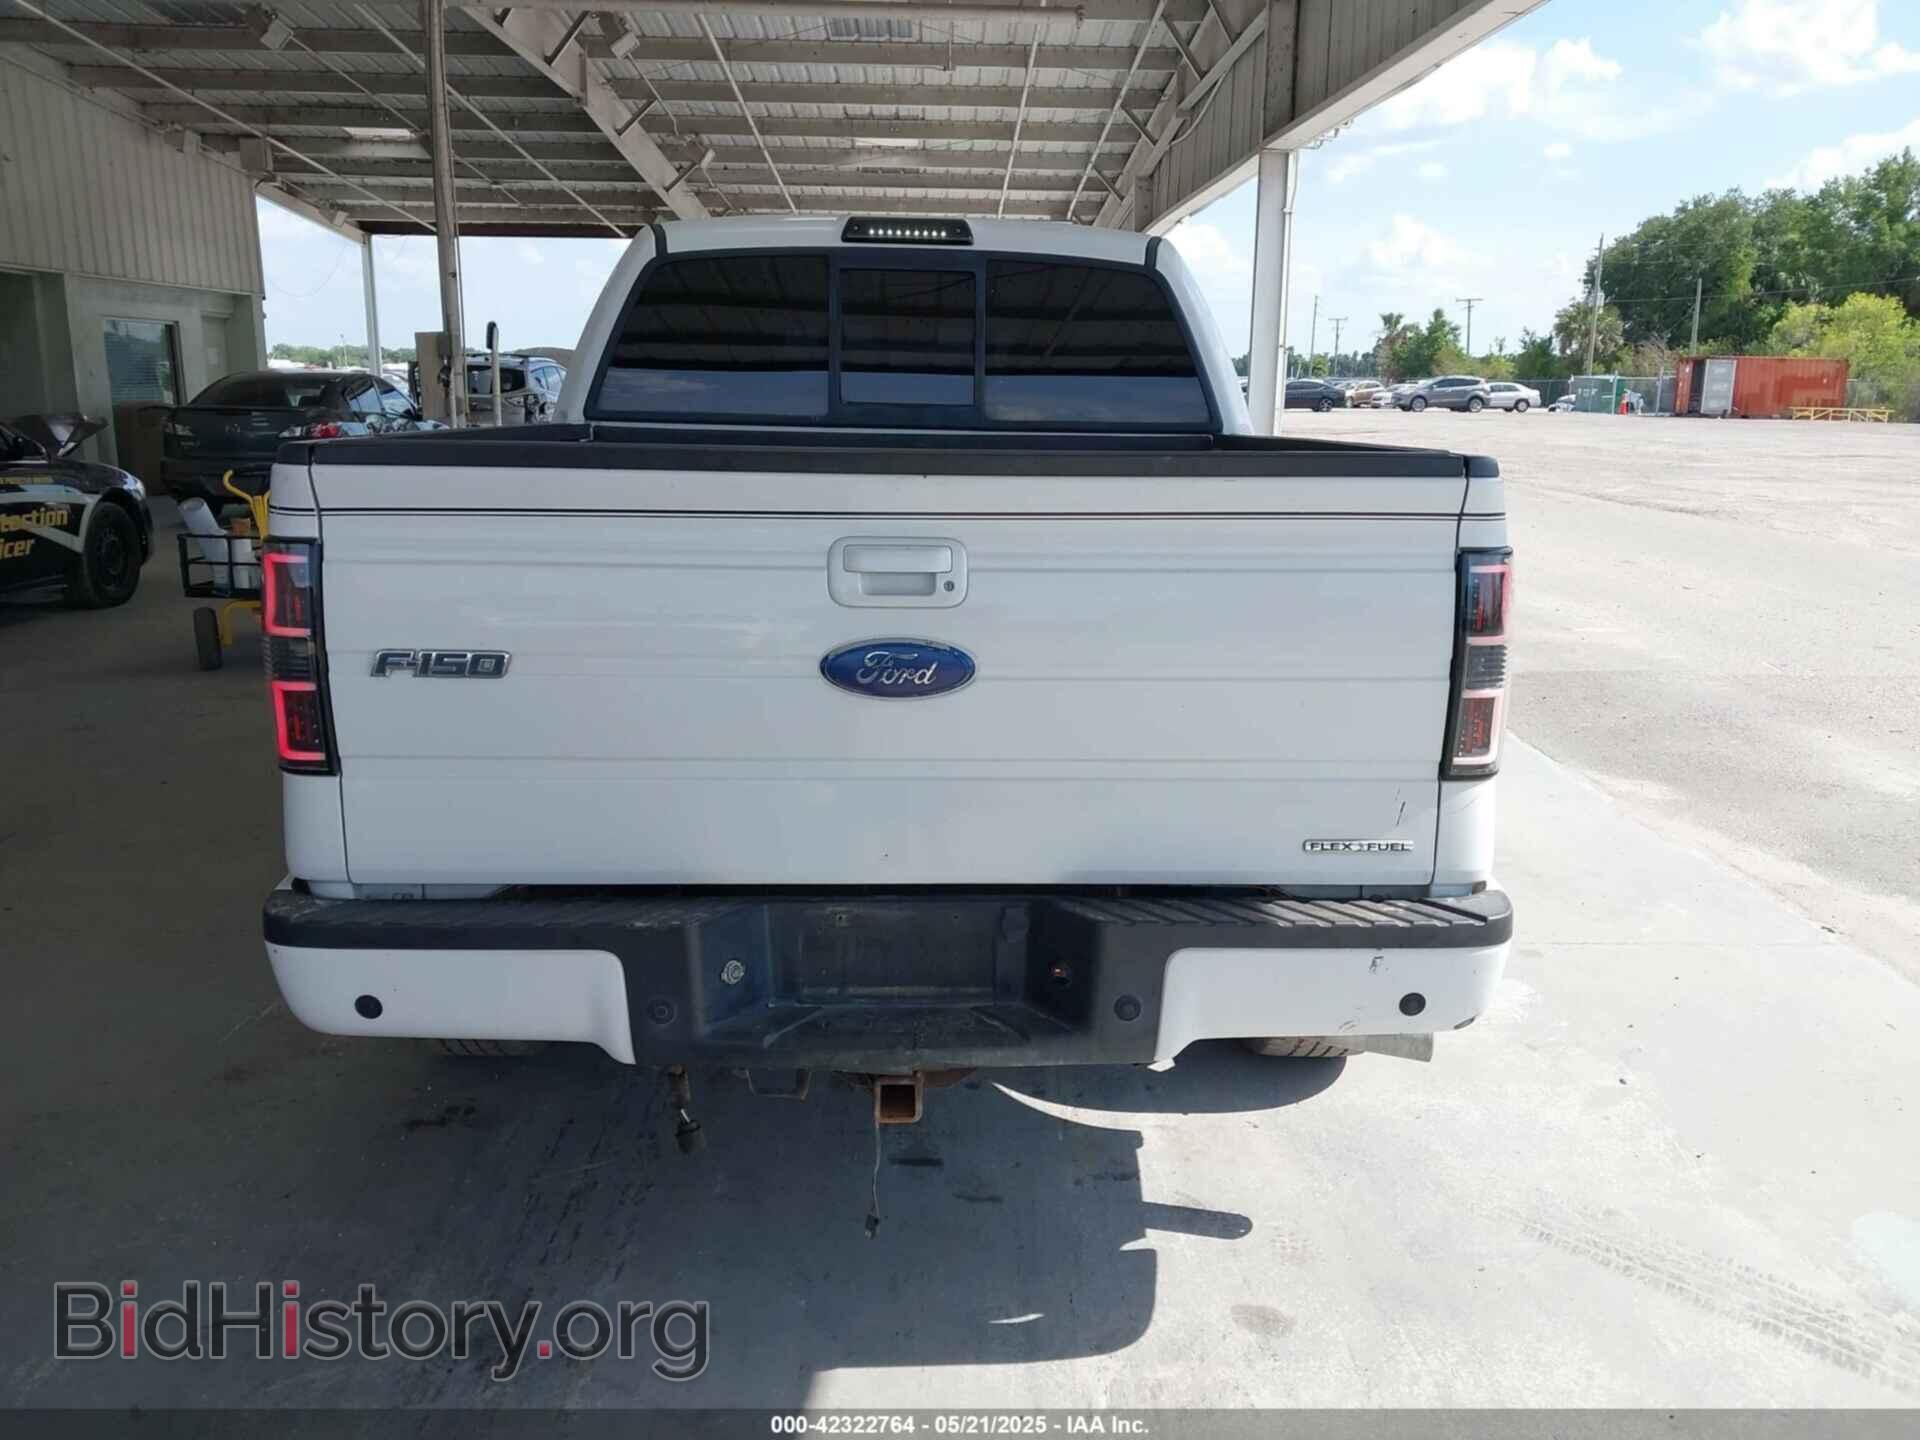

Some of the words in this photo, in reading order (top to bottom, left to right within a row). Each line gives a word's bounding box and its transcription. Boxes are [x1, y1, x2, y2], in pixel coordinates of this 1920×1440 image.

[856, 651, 938, 685] Ford
[1310, 842, 1352, 852] FLEX
[1367, 842, 1413, 852] FUEL
